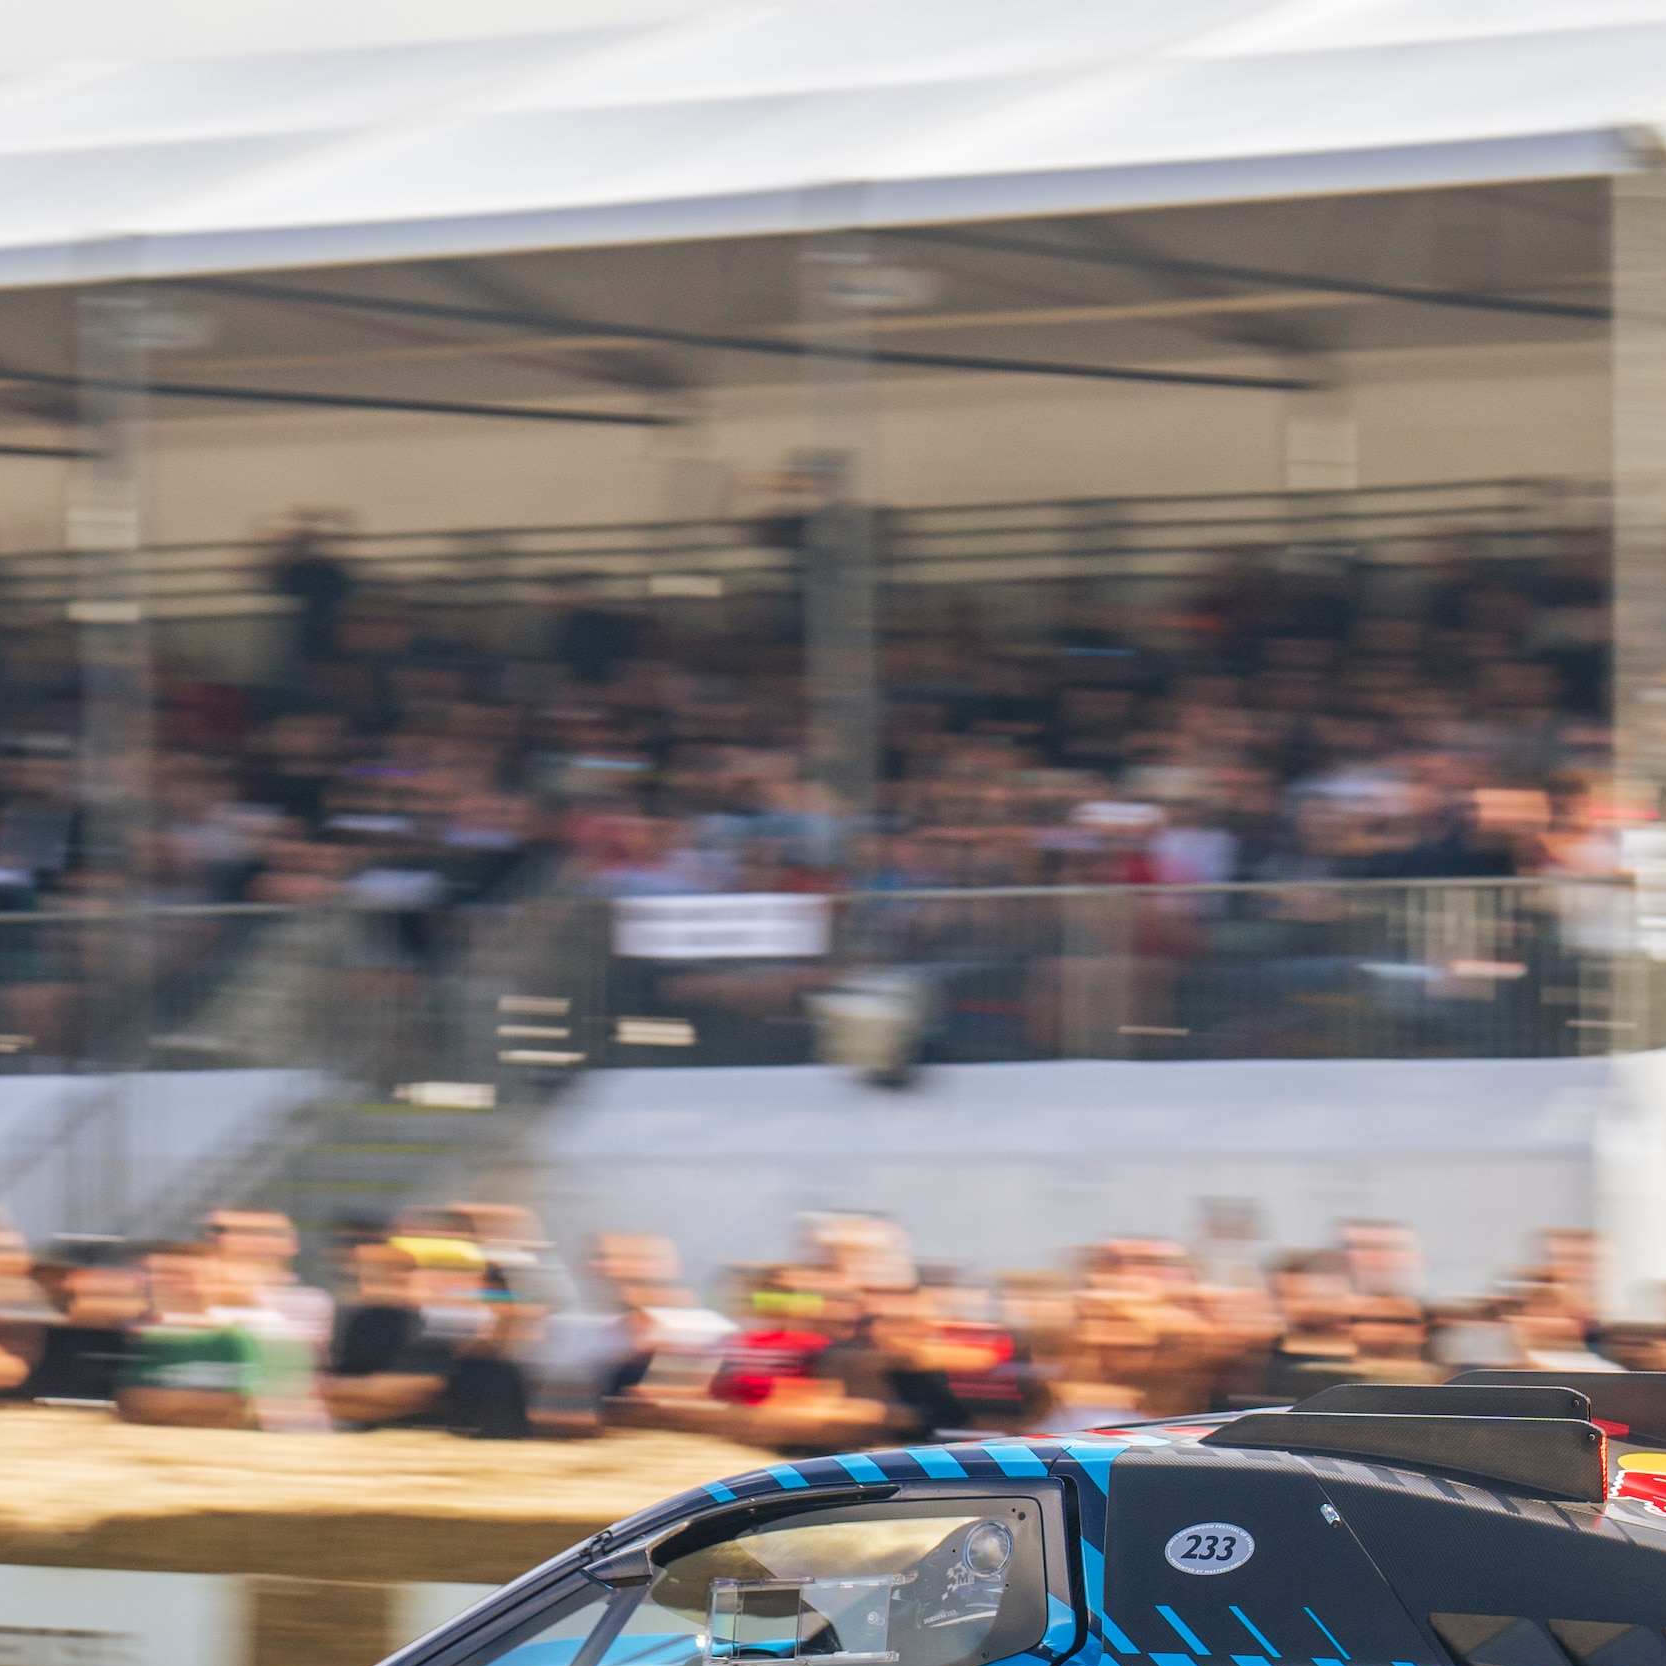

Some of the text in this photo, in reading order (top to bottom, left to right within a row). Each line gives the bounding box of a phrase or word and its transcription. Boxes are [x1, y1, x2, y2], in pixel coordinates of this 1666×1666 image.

[1179, 1524, 1215, 1537] GOODWOOD
[1215, 1524, 1240, 1534] FESTIVAL
[1180, 1534, 1236, 1561] 233
